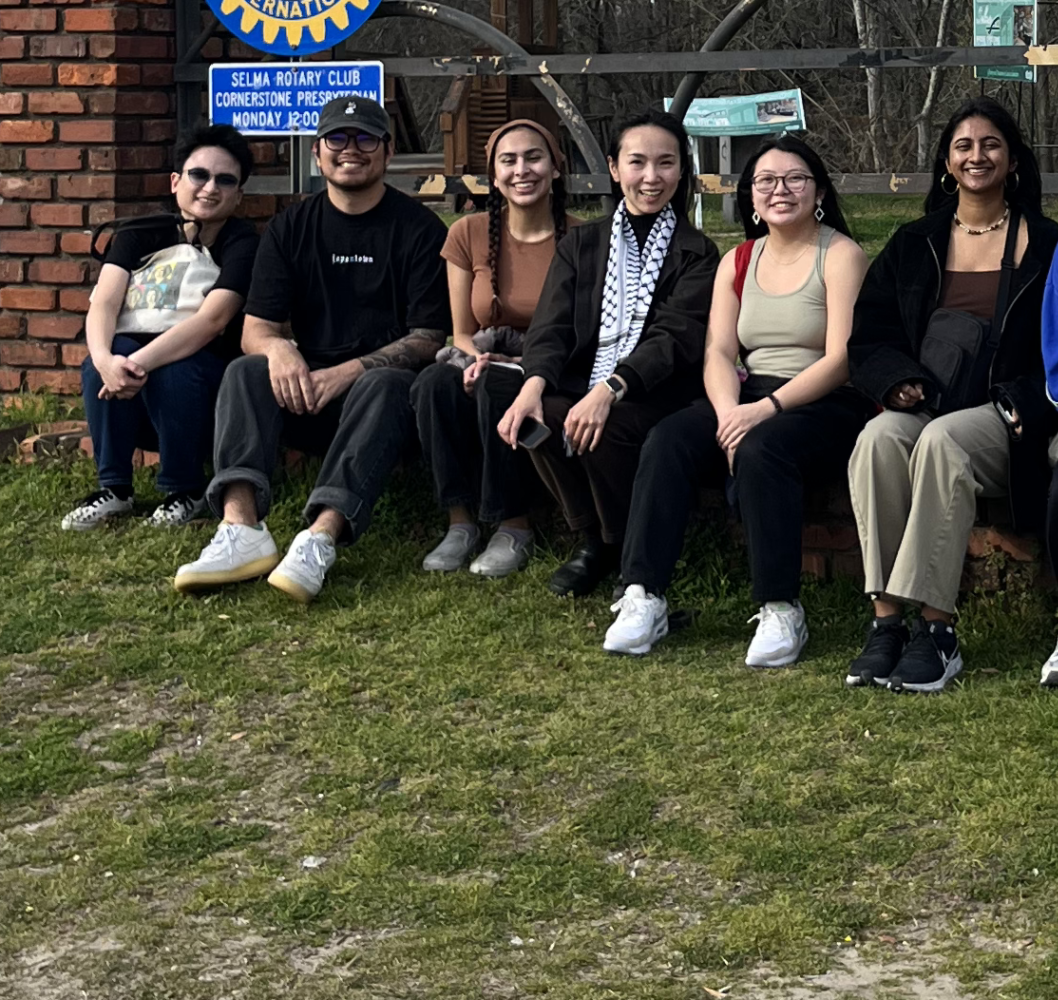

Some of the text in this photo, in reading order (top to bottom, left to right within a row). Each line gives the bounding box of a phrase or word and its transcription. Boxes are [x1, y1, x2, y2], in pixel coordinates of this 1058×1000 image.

[231, 70, 361, 87] SELMA ROTARY CLUB
[215, 91, 293, 107] CORNERSTONE
[232, 111, 319, 127] MONDAY 12:00
